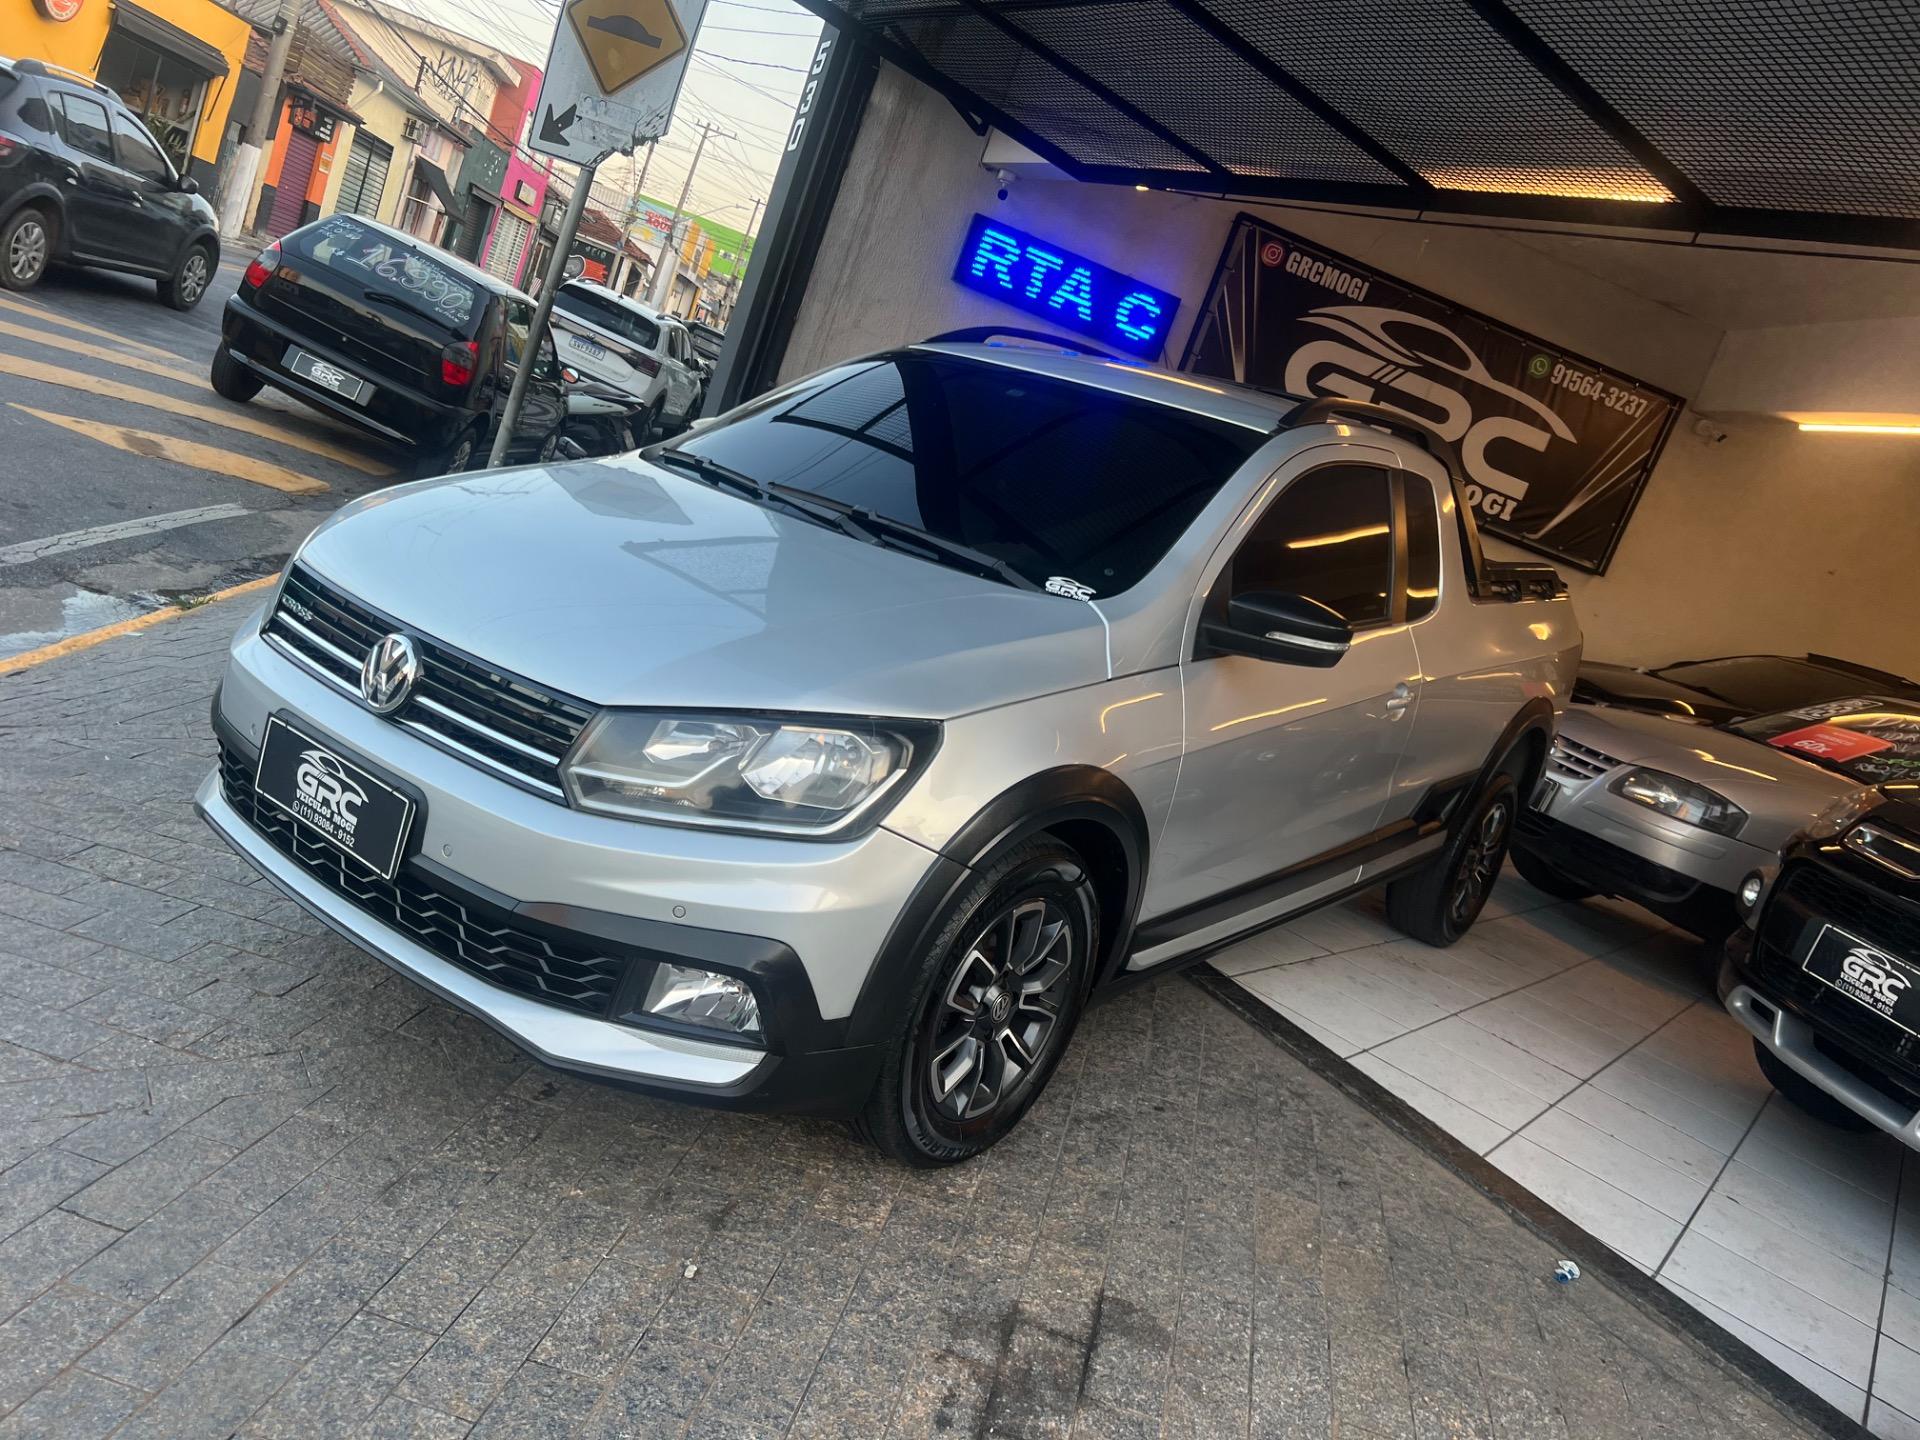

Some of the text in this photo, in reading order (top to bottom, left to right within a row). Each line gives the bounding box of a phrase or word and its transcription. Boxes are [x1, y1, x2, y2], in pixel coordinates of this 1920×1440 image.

[787, 40, 831, 151] 530
[972, 229, 1161, 340] RTA C
[1286, 252, 1370, 302] GRCMOGI
[1551, 364, 1648, 418] 91564-3237
[1045, 579, 1093, 600] GRC
[296, 788, 356, 834] VEICULOS MOGI
[297, 763, 362, 826] GRC
[300, 804, 313, 822] (11)
[313, 813, 335, 834] 93084
[337, 829, 356, 847] 9152
[1840, 971, 1895, 1007] VEICULOS MOGI
[1843, 955, 1905, 1002] GRC
[1876, 1002, 1894, 1016] 9152
